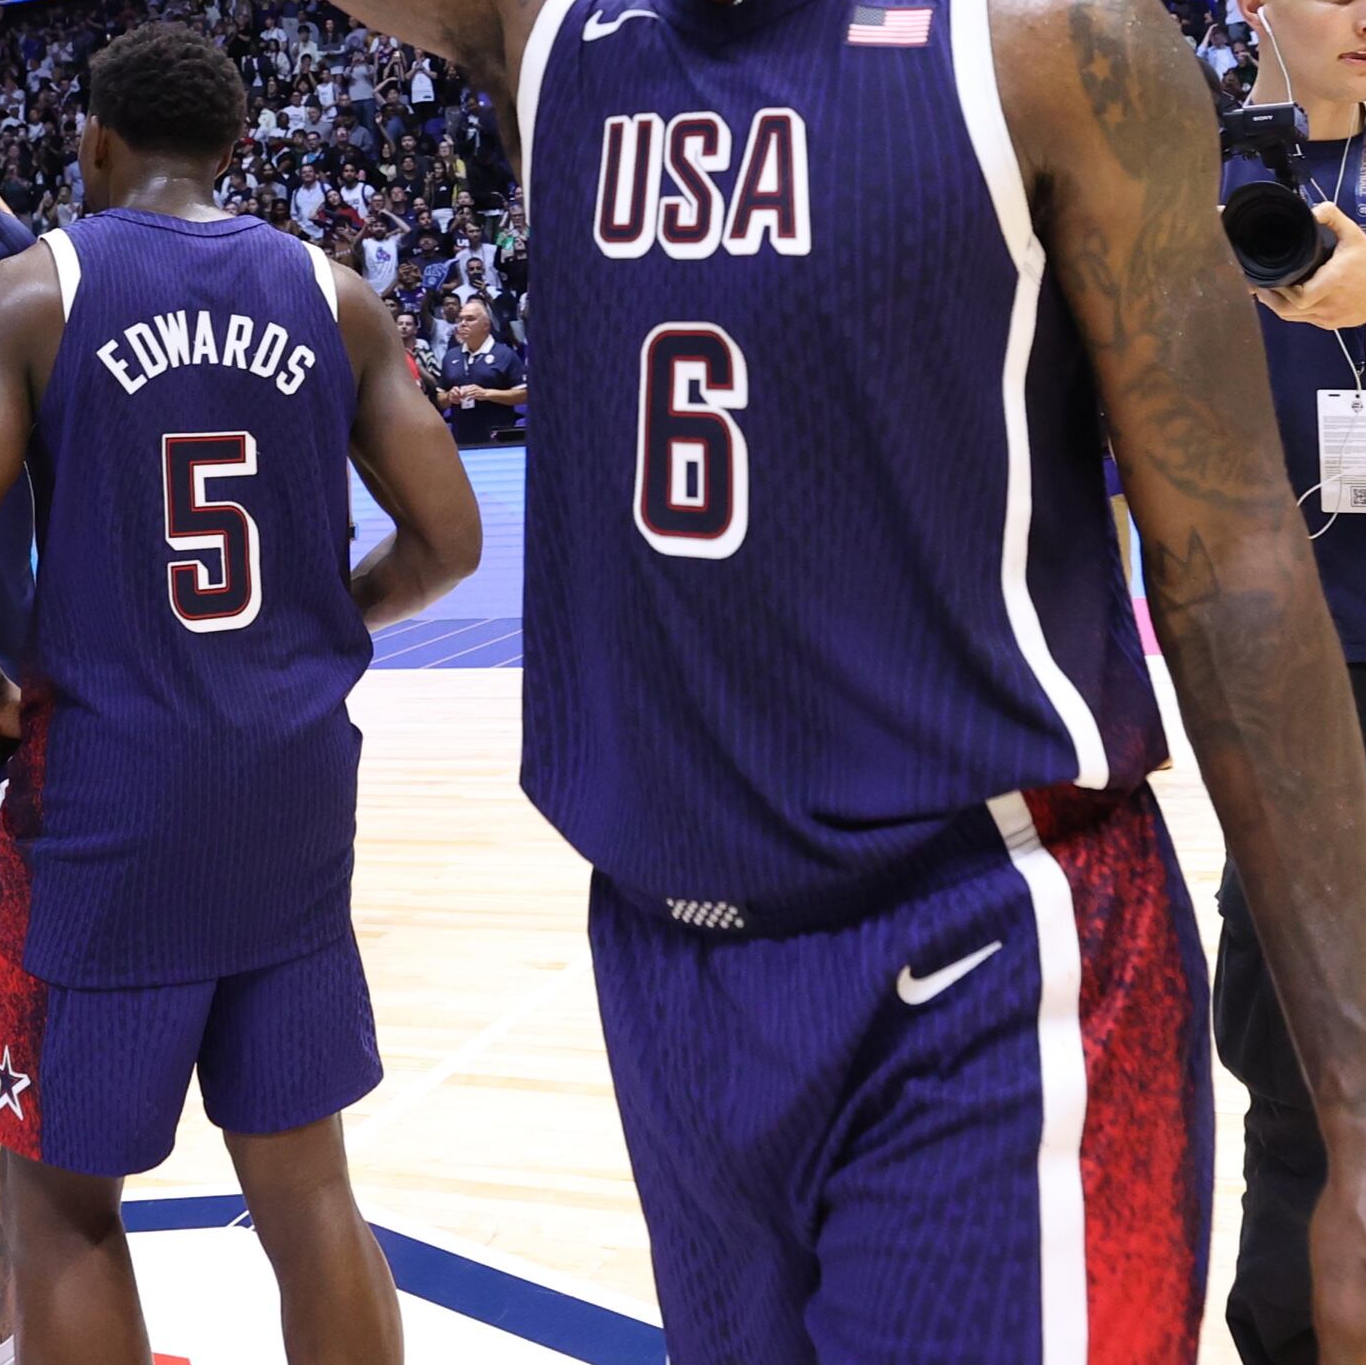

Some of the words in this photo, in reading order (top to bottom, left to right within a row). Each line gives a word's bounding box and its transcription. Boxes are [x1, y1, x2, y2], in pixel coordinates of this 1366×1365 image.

[593, 106, 812, 260] USA
[96, 310, 317, 396] EDWARDS
[633, 321, 749, 560] 6
[161, 430, 263, 634] 5
